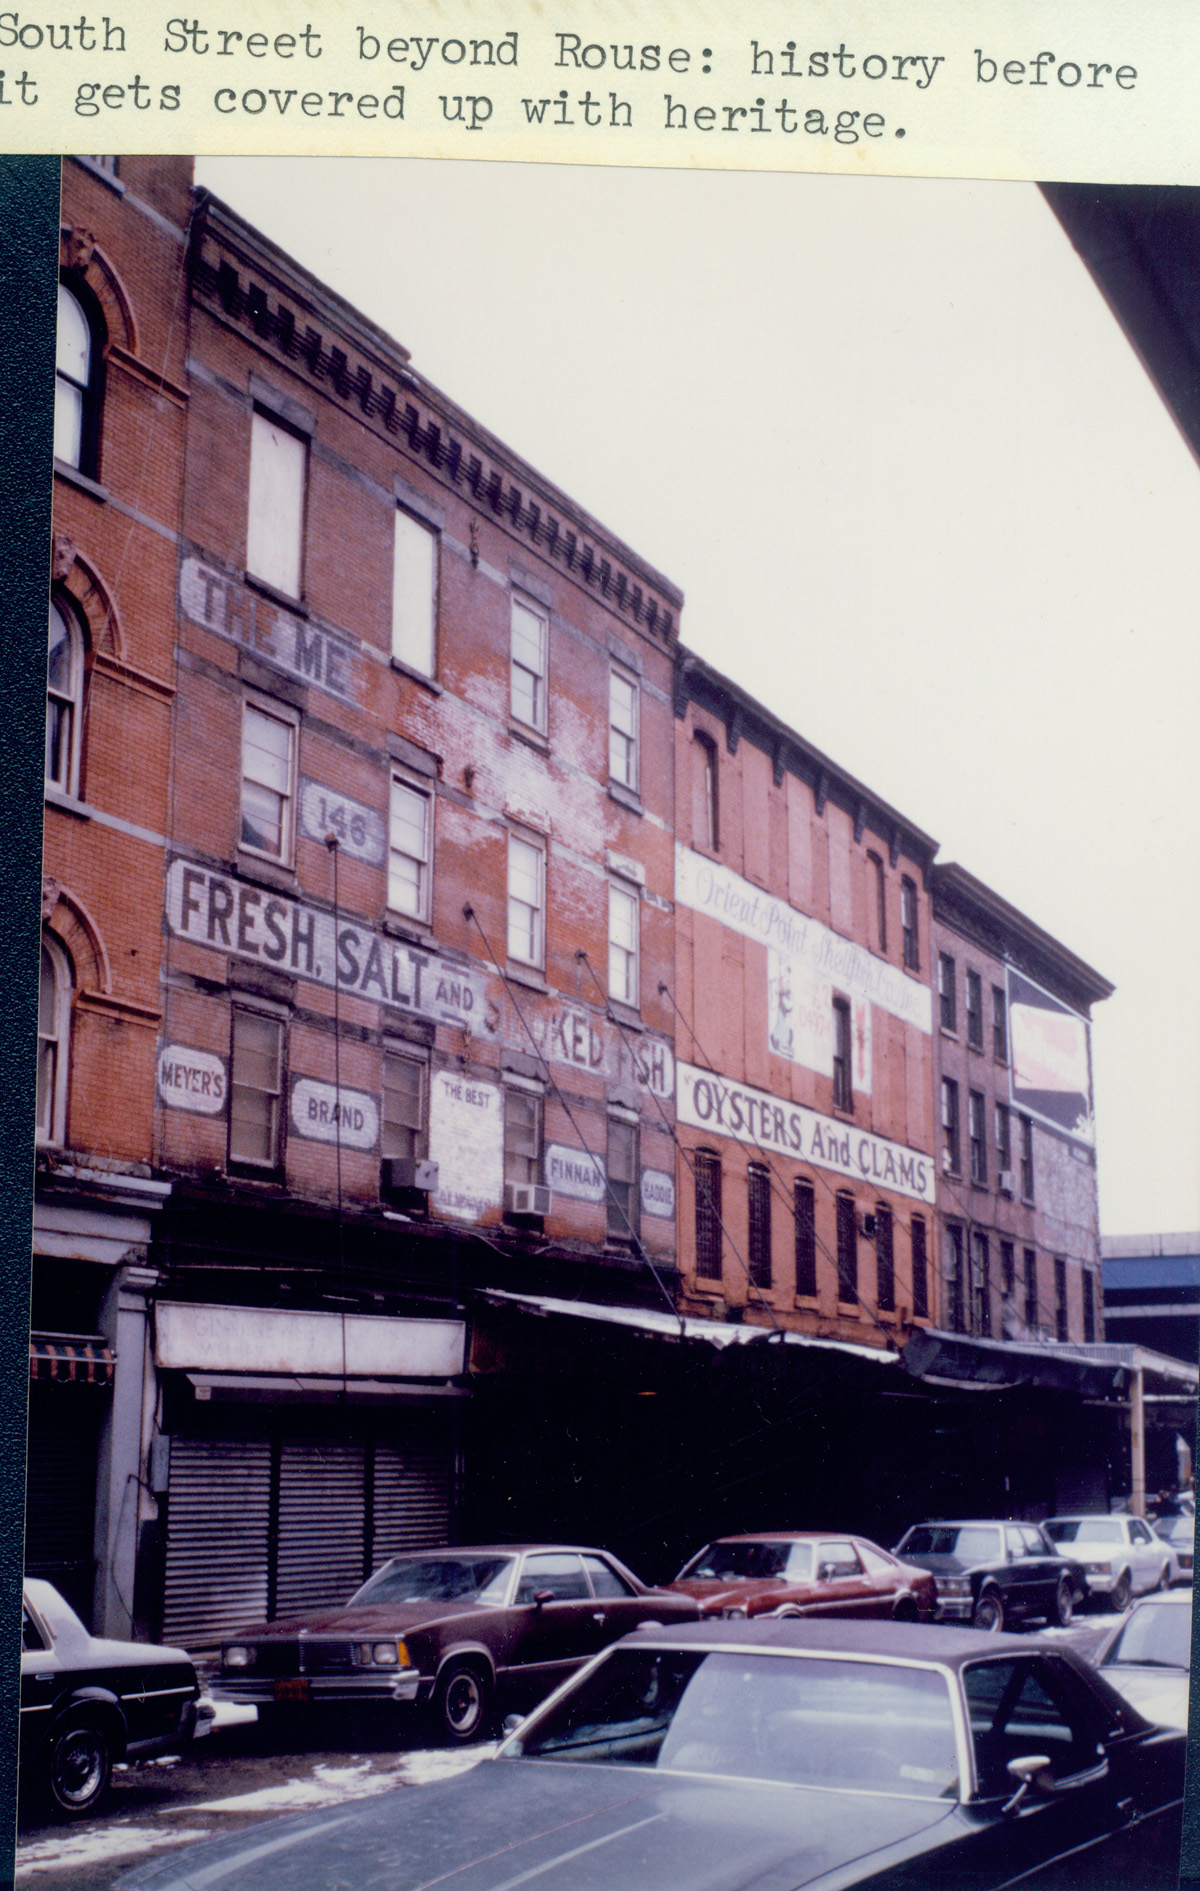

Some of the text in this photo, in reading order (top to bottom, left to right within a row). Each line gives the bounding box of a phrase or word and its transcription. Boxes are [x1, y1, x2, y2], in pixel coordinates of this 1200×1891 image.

[696, 867, 759, 928] Orient
[762, 900, 807, 955] Point
[181, 866, 321, 978] FRESH,
[337, 929, 429, 1009] SALT
[436, 978, 474, 1012] AND
[161, 1060, 225, 1099] MEYER'S
[442, 1079, 490, 1109] THE BEST
[308, 1096, 365, 1131] BRAND
[693, 1078, 927, 1193] OYSTERS And CLAMS
[551, 1157, 601, 1188] FINNAN
[643, 1180, 673, 1205] HADDIE
